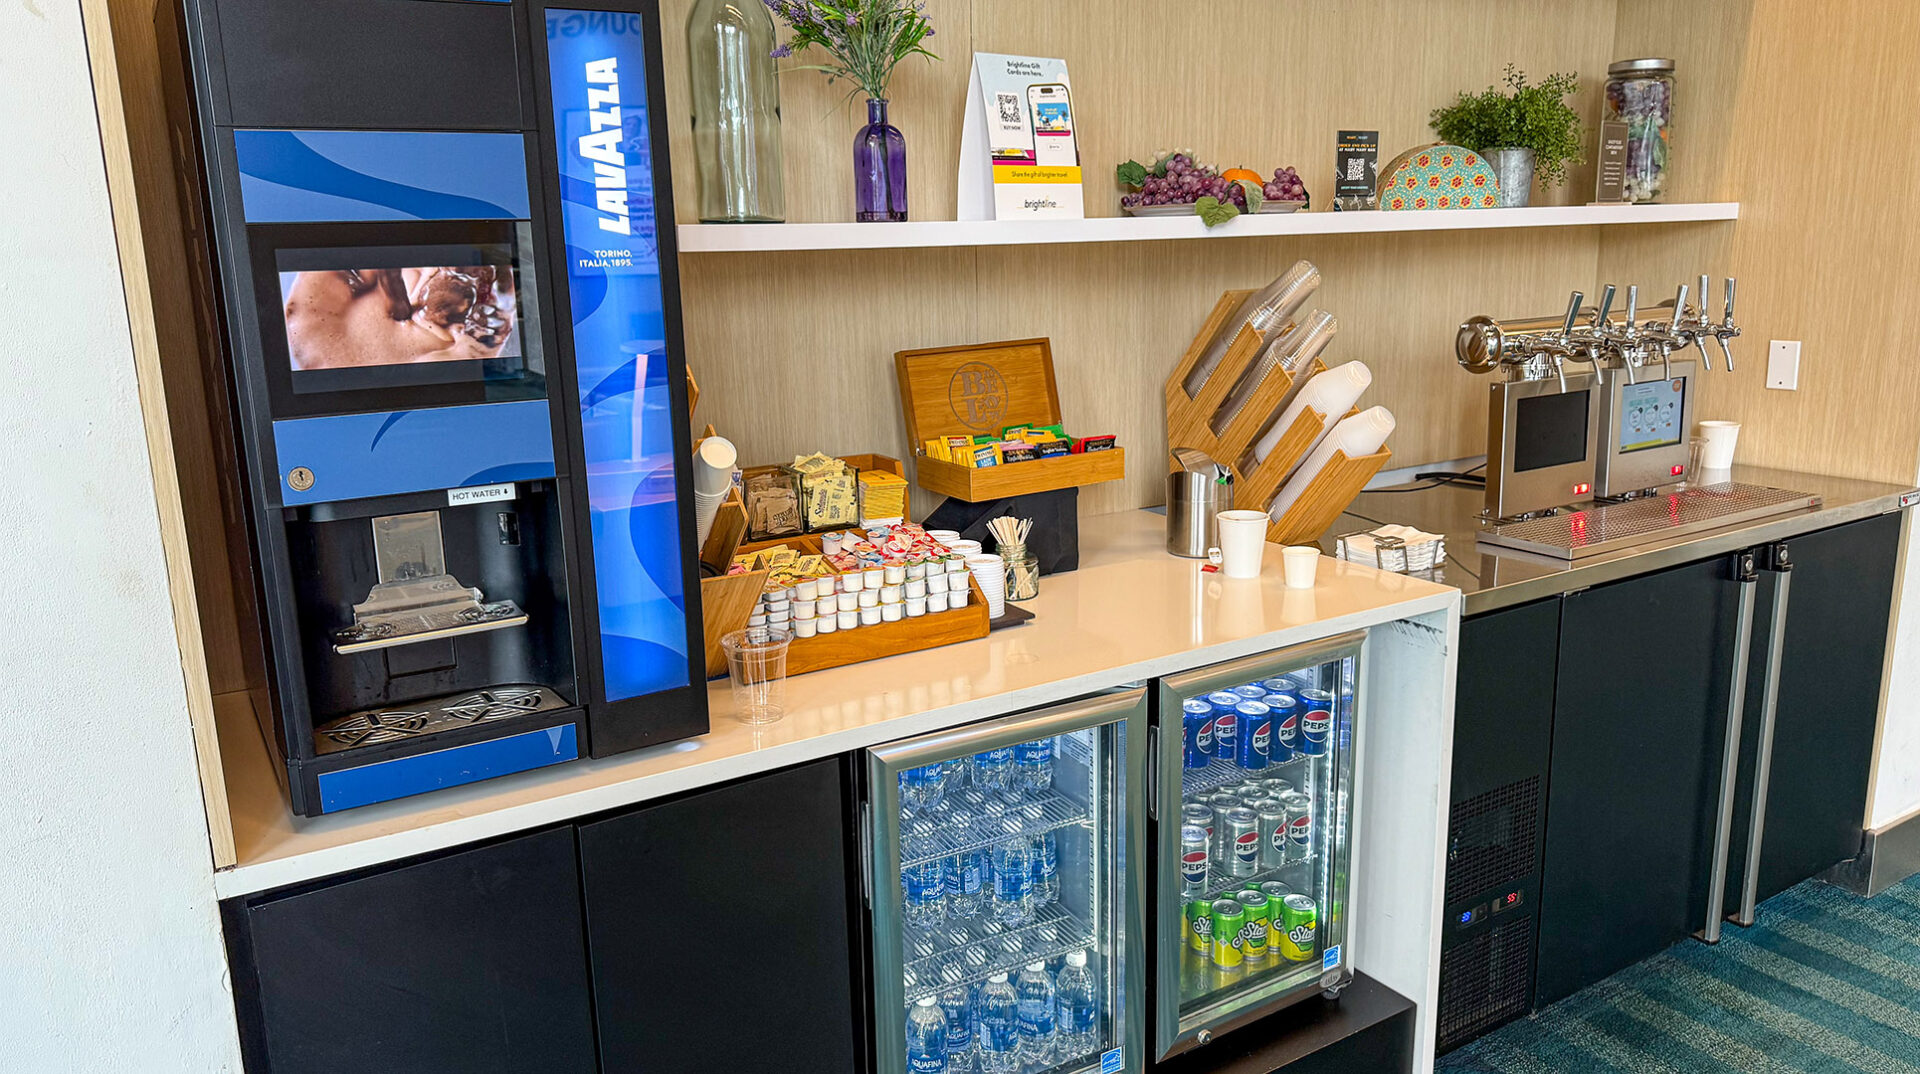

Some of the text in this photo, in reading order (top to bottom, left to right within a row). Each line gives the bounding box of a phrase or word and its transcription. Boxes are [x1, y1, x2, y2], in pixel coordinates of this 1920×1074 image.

[579, 57, 631, 236] LAVAZZA
[1024, 197, 1057, 211] brightline
[453, 489, 500, 500] HOT WATER
